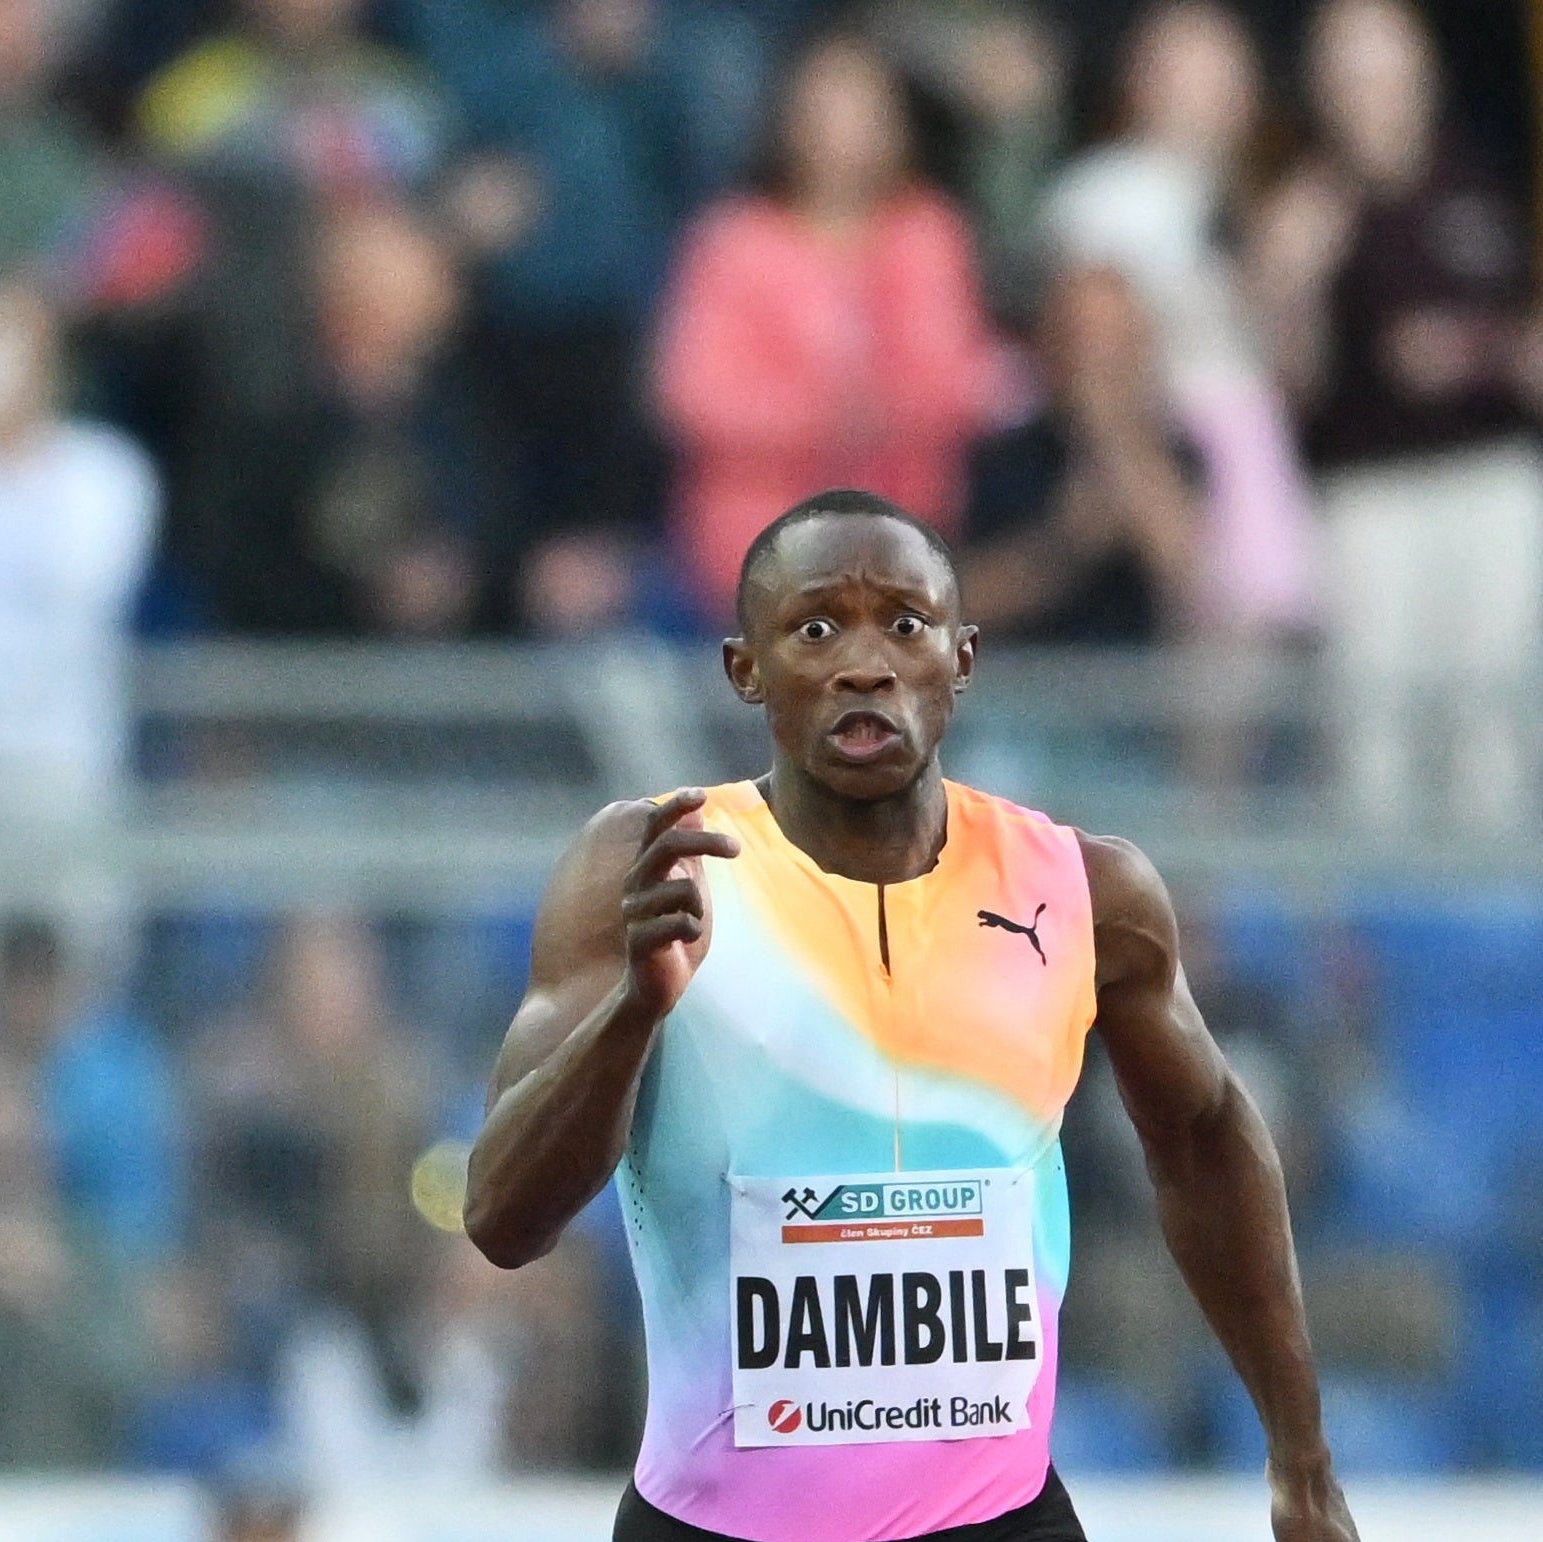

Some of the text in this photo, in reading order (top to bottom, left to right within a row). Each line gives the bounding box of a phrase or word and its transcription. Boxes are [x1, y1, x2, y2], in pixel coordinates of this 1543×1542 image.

[841, 1187, 975, 1213] SD GROUP
[867, 1226, 909, 1239] Skupiny
[911, 1223, 933, 1235] ČEZ
[737, 1268, 1036, 1370] DAMBILE
[806, 1395, 1013, 1431] UniCredit Bank
